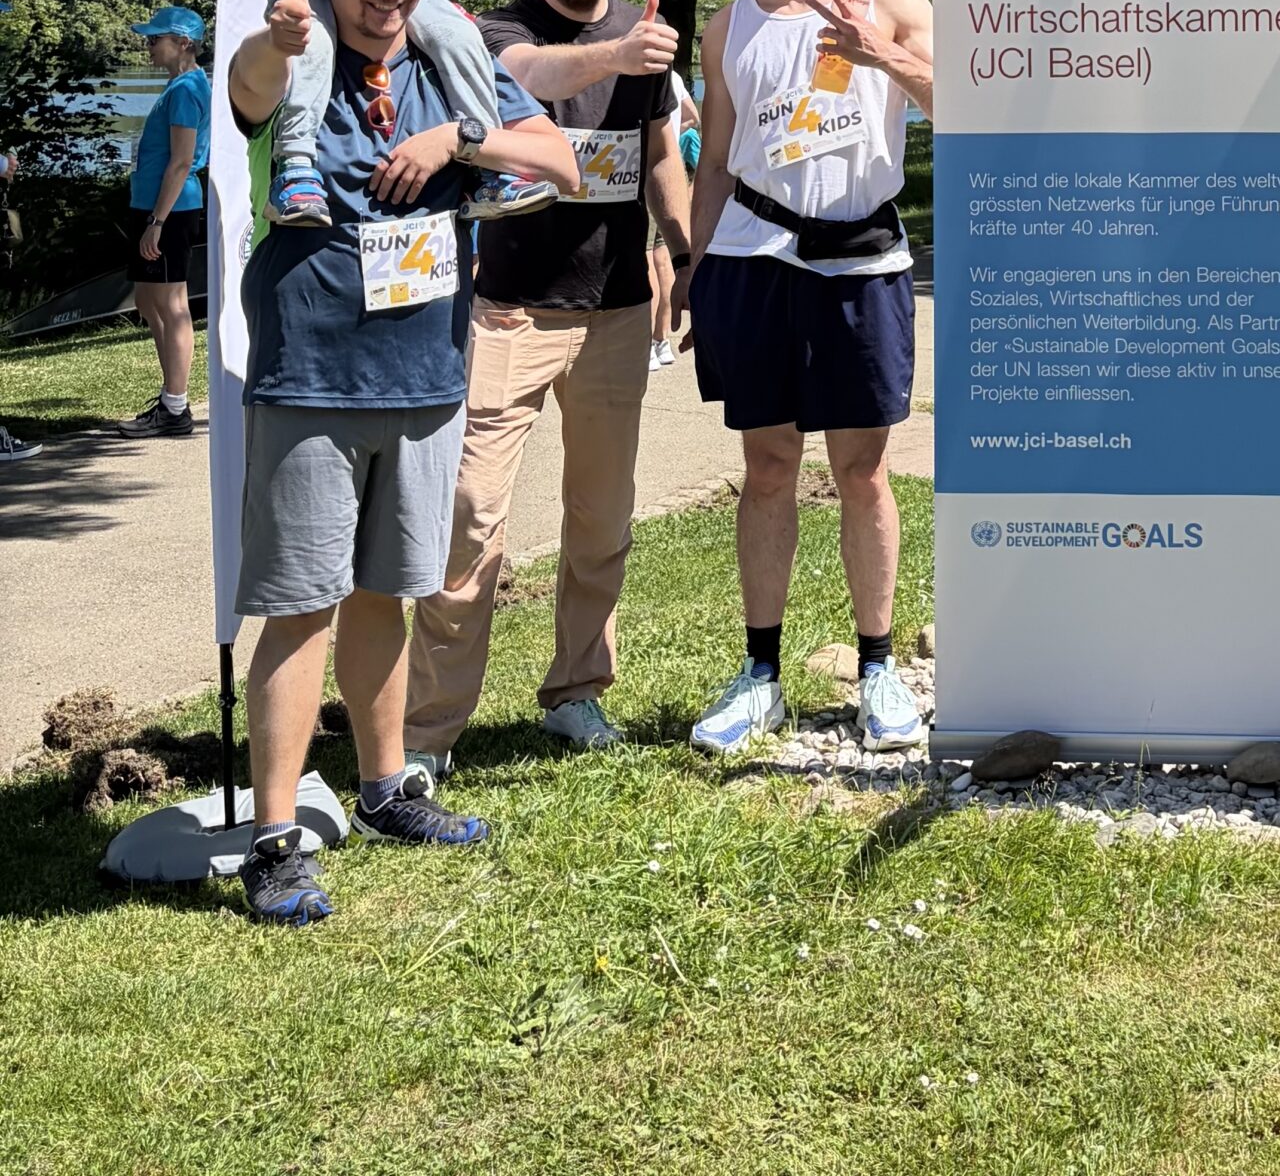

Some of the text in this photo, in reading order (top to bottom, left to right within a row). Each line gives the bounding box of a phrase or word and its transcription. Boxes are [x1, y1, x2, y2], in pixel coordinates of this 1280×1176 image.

[969, 46, 1152, 86] (JCI Basel)
[758, 101, 793, 127] RUN
[788, 96, 822, 133] 4
[818, 111, 862, 136] KIDS
[572, 141, 639, 185] UN 4 KIDS
[969, 172, 998, 189] Wir
[1002, 172, 1037, 189] sind
[1043, 172, 1069, 189] die
[1075, 172, 1122, 189] lokale
[1128, 172, 1200, 189] Kammer
[1206, 172, 1237, 189] des
[969, 197, 1042, 216] grössten
[1048, 196, 1135, 212] Netzwerks
[1141, 196, 1164, 212] für
[1168, 196, 1216, 216] junge
[403, 222, 418, 231] JCI
[970, 219, 1159, 236] kräfte unter 40 Jahren.
[362, 231, 458, 281] RUN 4 KIDS
[969, 266, 1280, 287] Wir engagieren uns in den Bereichen
[969, 290, 1255, 308] Soziales, Wirtschaftliches und der
[970, 314, 1077, 333] persönlichen
[1082, 313, 1200, 334] Weiterbildung.
[1207, 314, 1234, 331] Als
[970, 337, 999, 353] der
[1004, 336, 1109, 354] «Sustainable
[1114, 337, 1225, 358] Development
[970, 361, 999, 377] der
[1004, 361, 1031, 377] UN
[1037, 361, 1091, 377] lassen
[1096, 362, 1121, 377] wir
[1126, 362, 1171, 378] diese
[1176, 362, 1217, 378] aktiv
[1222, 362, 1236, 378] in
[970, 385, 1135, 404] Projekte einfliessen.
[970, 432, 1132, 451] www.jci-basel.ch
[1006, 522, 1100, 534] SUSTAINABLE
[1101, 522, 1203, 549] GOALS
[1006, 535, 1099, 548] DEVELOPMENT
